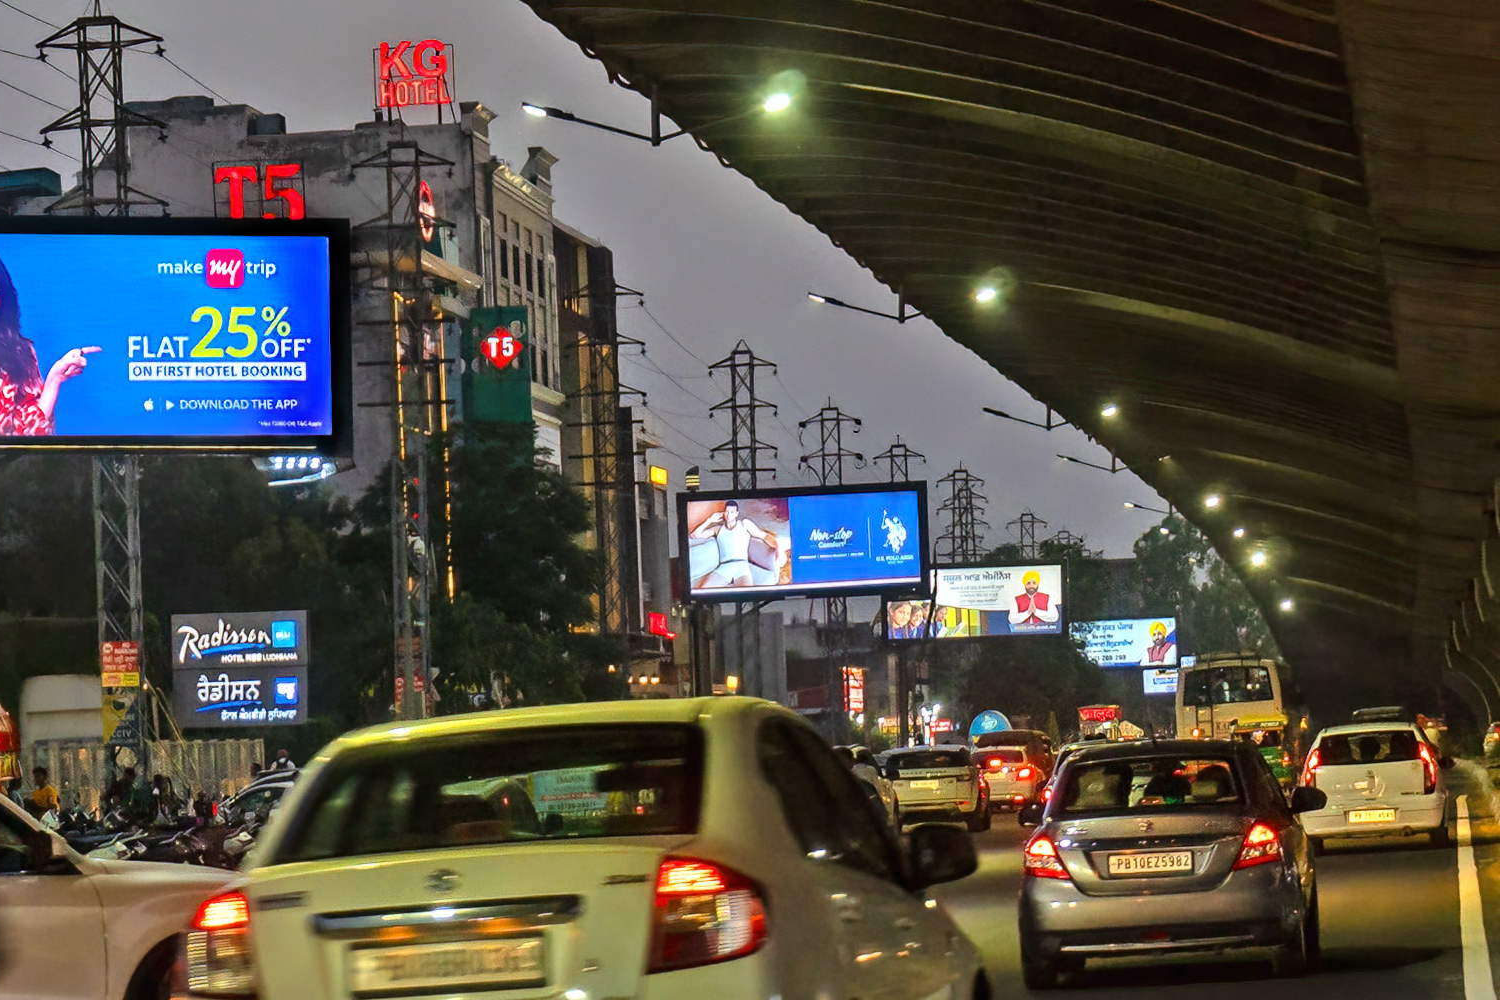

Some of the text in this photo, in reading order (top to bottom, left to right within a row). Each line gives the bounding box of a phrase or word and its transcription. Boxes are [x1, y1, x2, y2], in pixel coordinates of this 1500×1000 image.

[380, 39, 448, 80] KG
[380, 78, 452, 107] HOTEL
[214, 163, 305, 220] T5
[157, 259, 277, 286] make my trip
[128, 335, 189, 358] FLAT
[487, 336, 514, 358] T5
[132, 365, 303, 377] ON FIRST HOTEL BOOKING
[180, 399, 298, 411] DOWNLOAD THE APP
[177, 618, 271, 664] Radisson
[221, 653, 244, 663] HOTEL
[1117, 855, 1189, 870] PB10EZ5982
